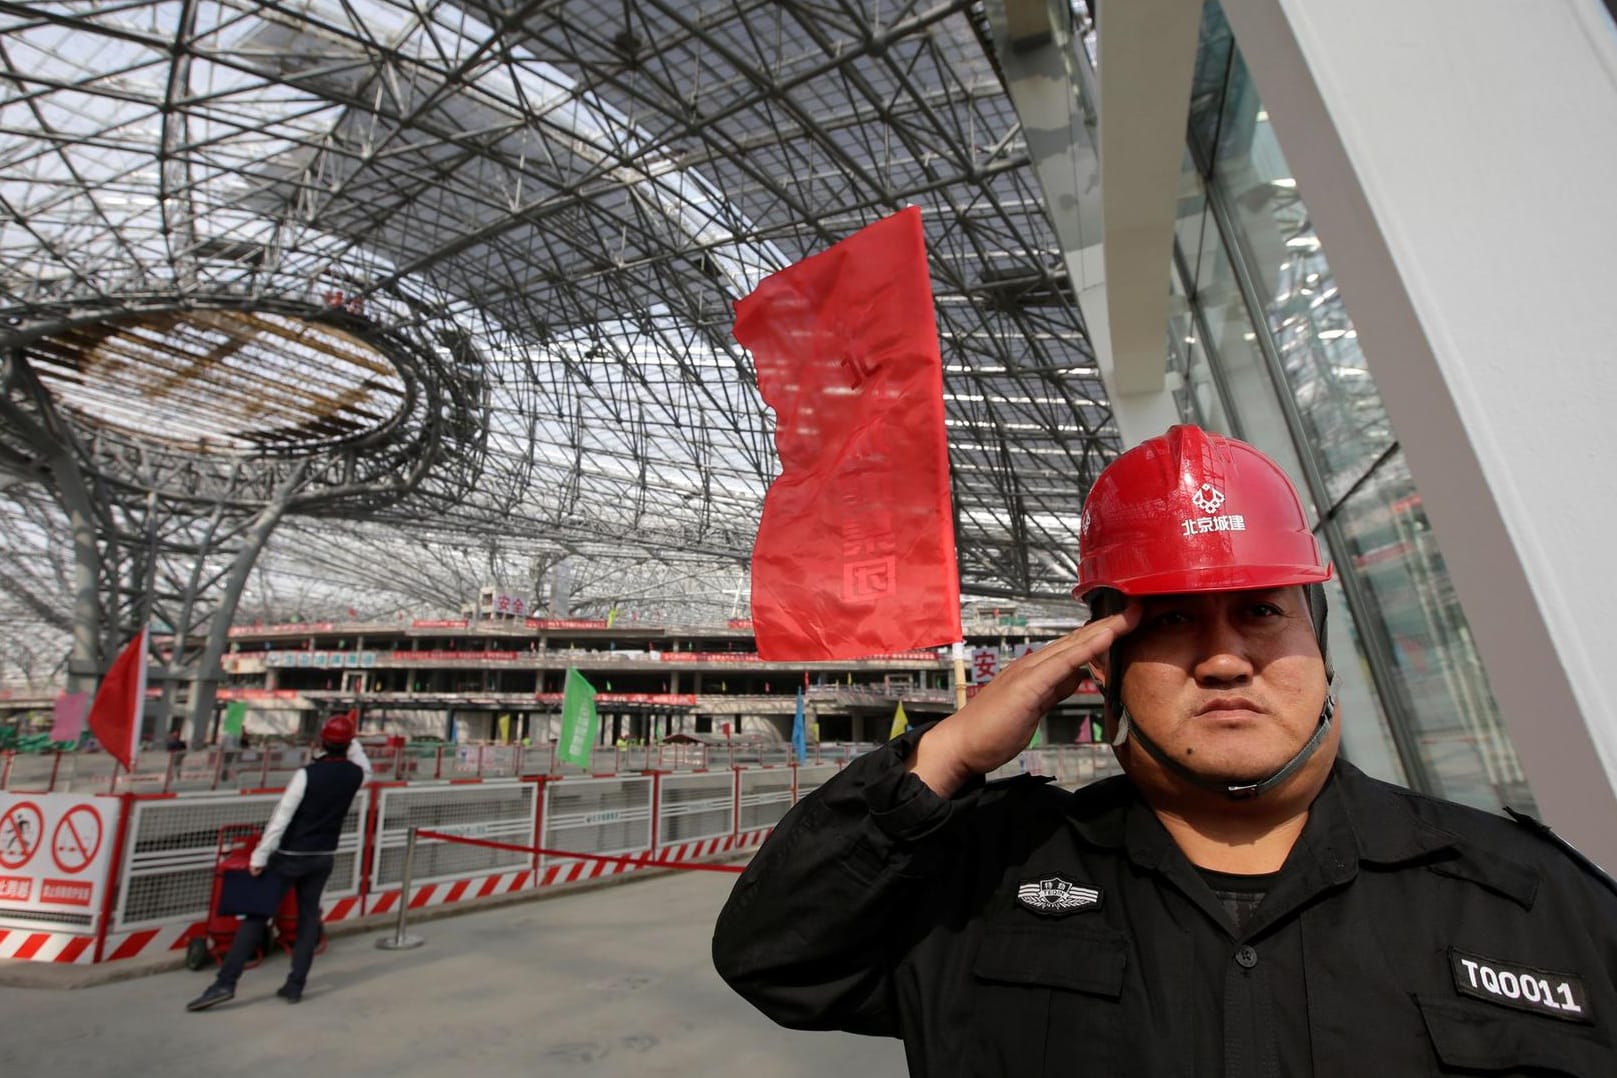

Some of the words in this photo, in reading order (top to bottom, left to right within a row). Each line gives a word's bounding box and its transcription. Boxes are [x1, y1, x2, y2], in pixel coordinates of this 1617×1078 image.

[1182, 516, 1246, 536] 北京城建
[1462, 960, 1581, 1012] TQ0011
